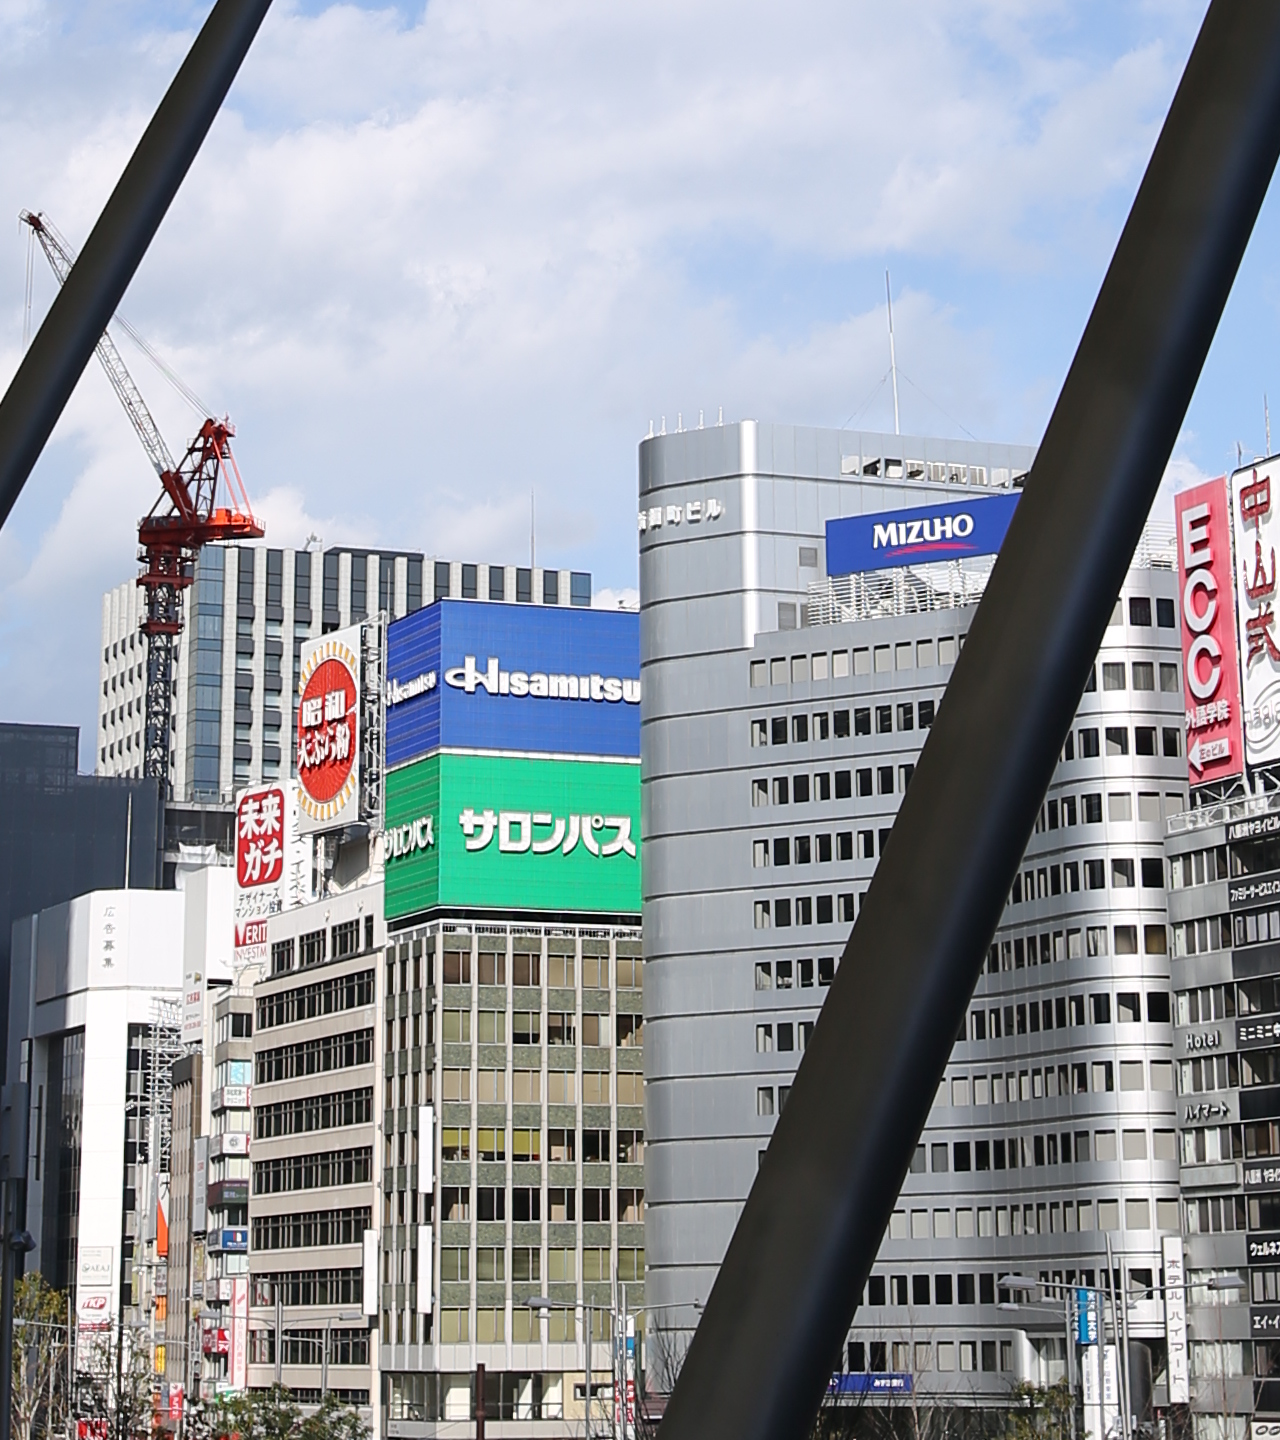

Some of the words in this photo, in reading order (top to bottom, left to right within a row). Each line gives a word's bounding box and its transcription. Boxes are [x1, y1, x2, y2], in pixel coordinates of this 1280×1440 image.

[873, 514, 974, 549] MIZUHO
[1181, 502, 1222, 700] ECC
[444, 655, 641, 703] Hisamitsu
[301, 689, 346, 727] 昭和
[1185, 698, 1231, 730] 外語学院
[298, 722, 350, 768] 天ぷら粉
[239, 794, 281, 840] 未来
[459, 808, 636, 858] サロンパス
[243, 837, 282, 883] ガチ
[235, 899, 283, 918] マンション投資
[238, 887, 280, 906] デザイナーズ
[1186, 1030, 1219, 1049] Hotel
[1185, 1102, 1227, 1120] ハイマート
